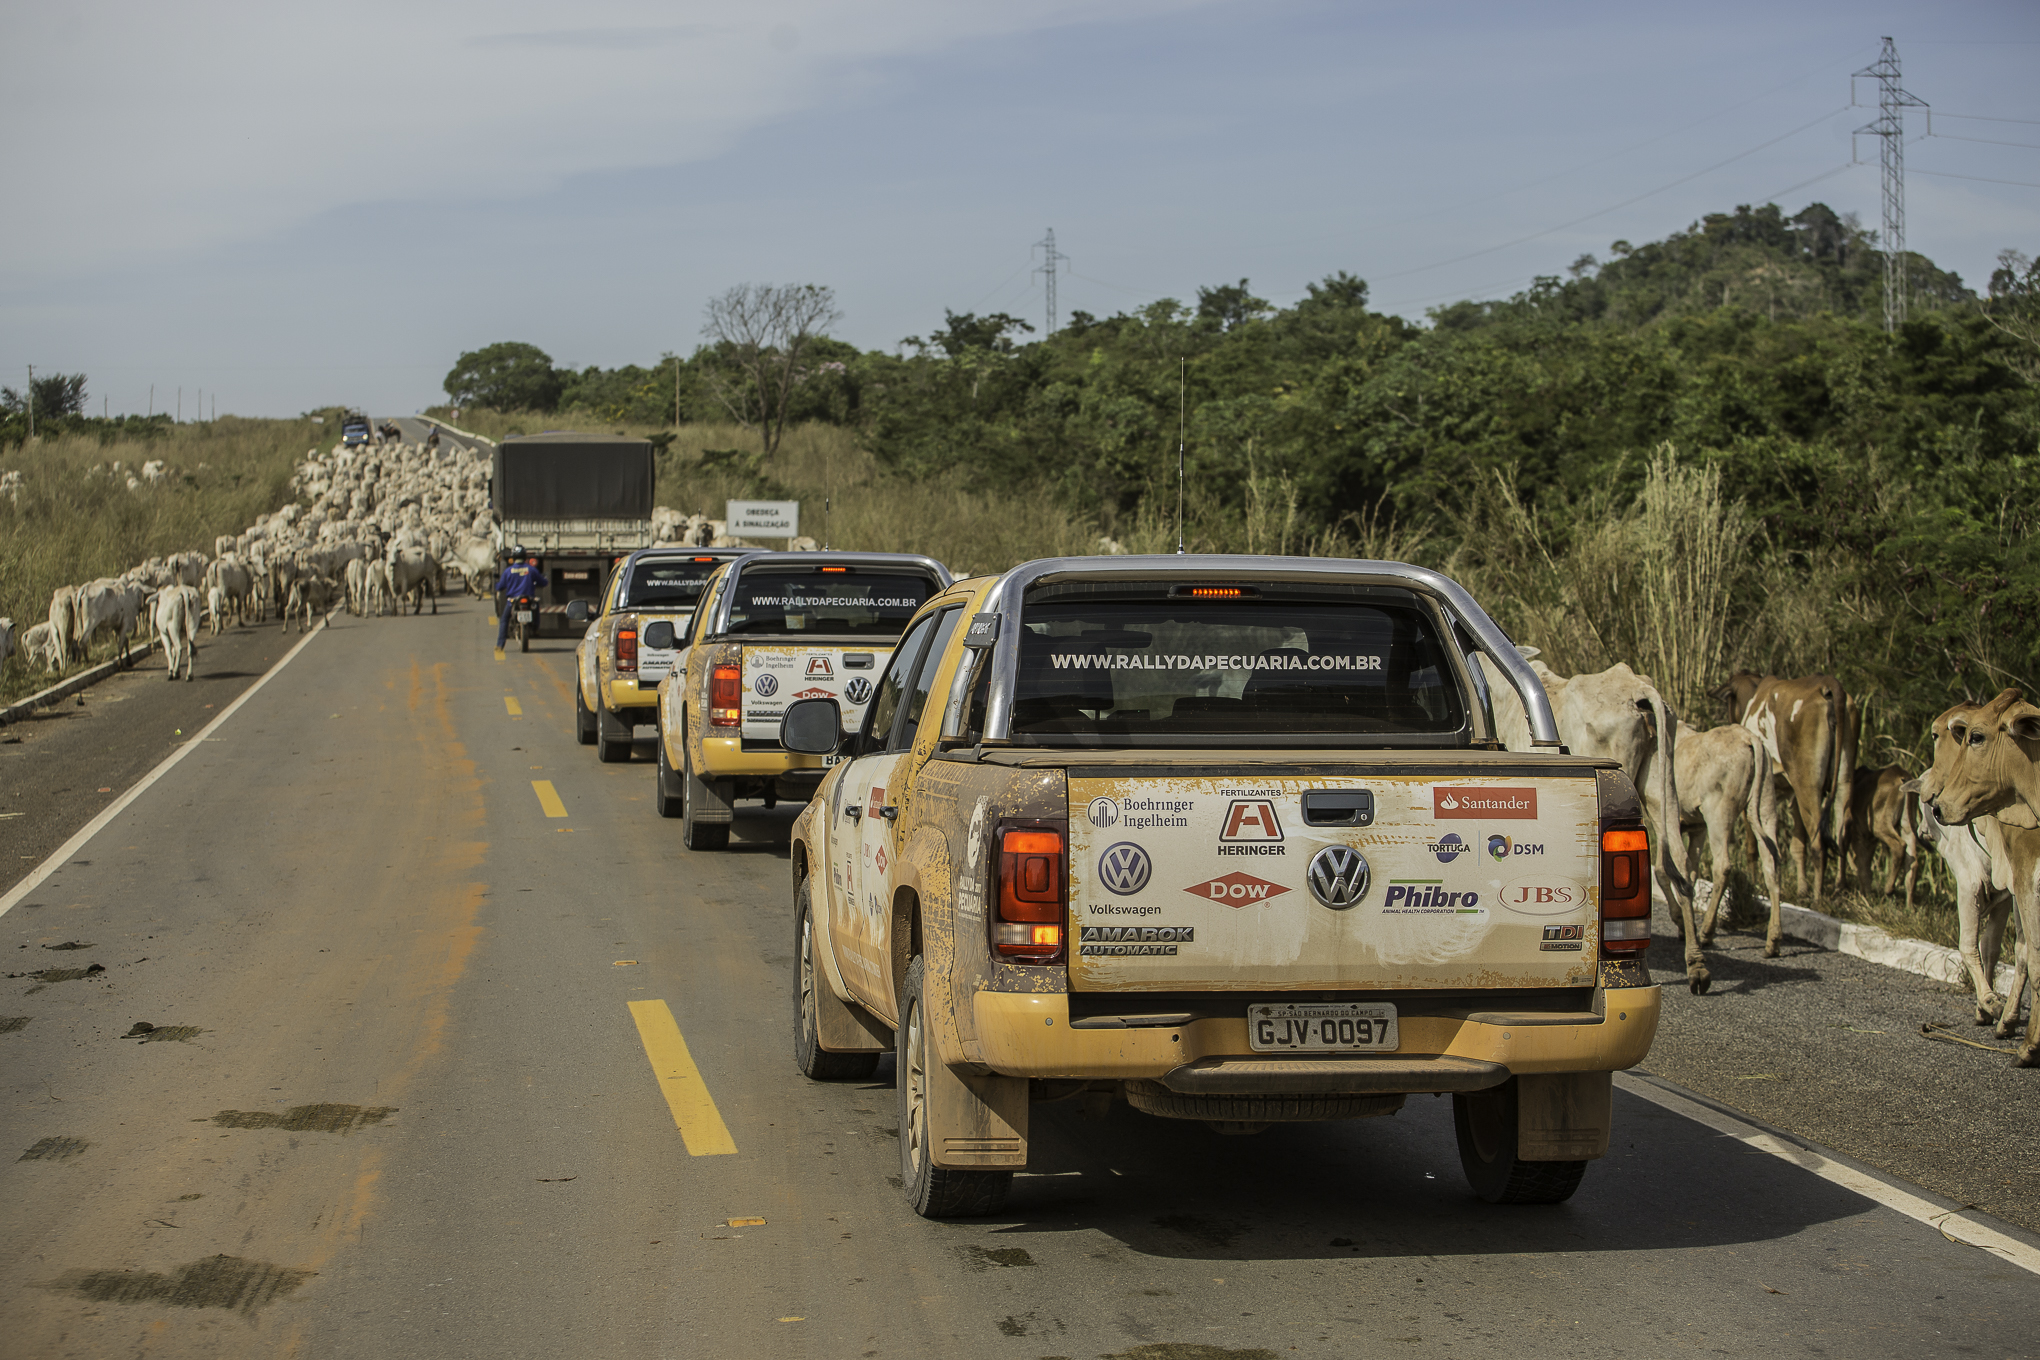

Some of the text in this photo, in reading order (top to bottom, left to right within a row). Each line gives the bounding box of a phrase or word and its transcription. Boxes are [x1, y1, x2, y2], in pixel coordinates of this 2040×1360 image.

[752, 596, 917, 607] WWW.RALLYDAPECUARIA.COM.BR
[1051, 654, 1382, 671] WWW.RALLYDAPECUARIA.COM.BR
[1220, 789, 1282, 797] FERTILIZANTES
[1123, 798, 1194, 813] Boehringer
[1461, 796, 1530, 810] Santander
[1123, 814, 1188, 829] Ingelheim
[1217, 845, 1286, 856] HERINGER
[1428, 844, 1471, 853] TORTUGA
[1513, 844, 1544, 855] DSM
[1384, 886, 1479, 907] Phibro
[1513, 886, 1572, 903] JBS
[1089, 904, 1161, 917] Volkswagen
[1082, 927, 1194, 942] AMAROK
[1545, 925, 1584, 940] TDI
[1080, 945, 1177, 955] AUTOMATIC
